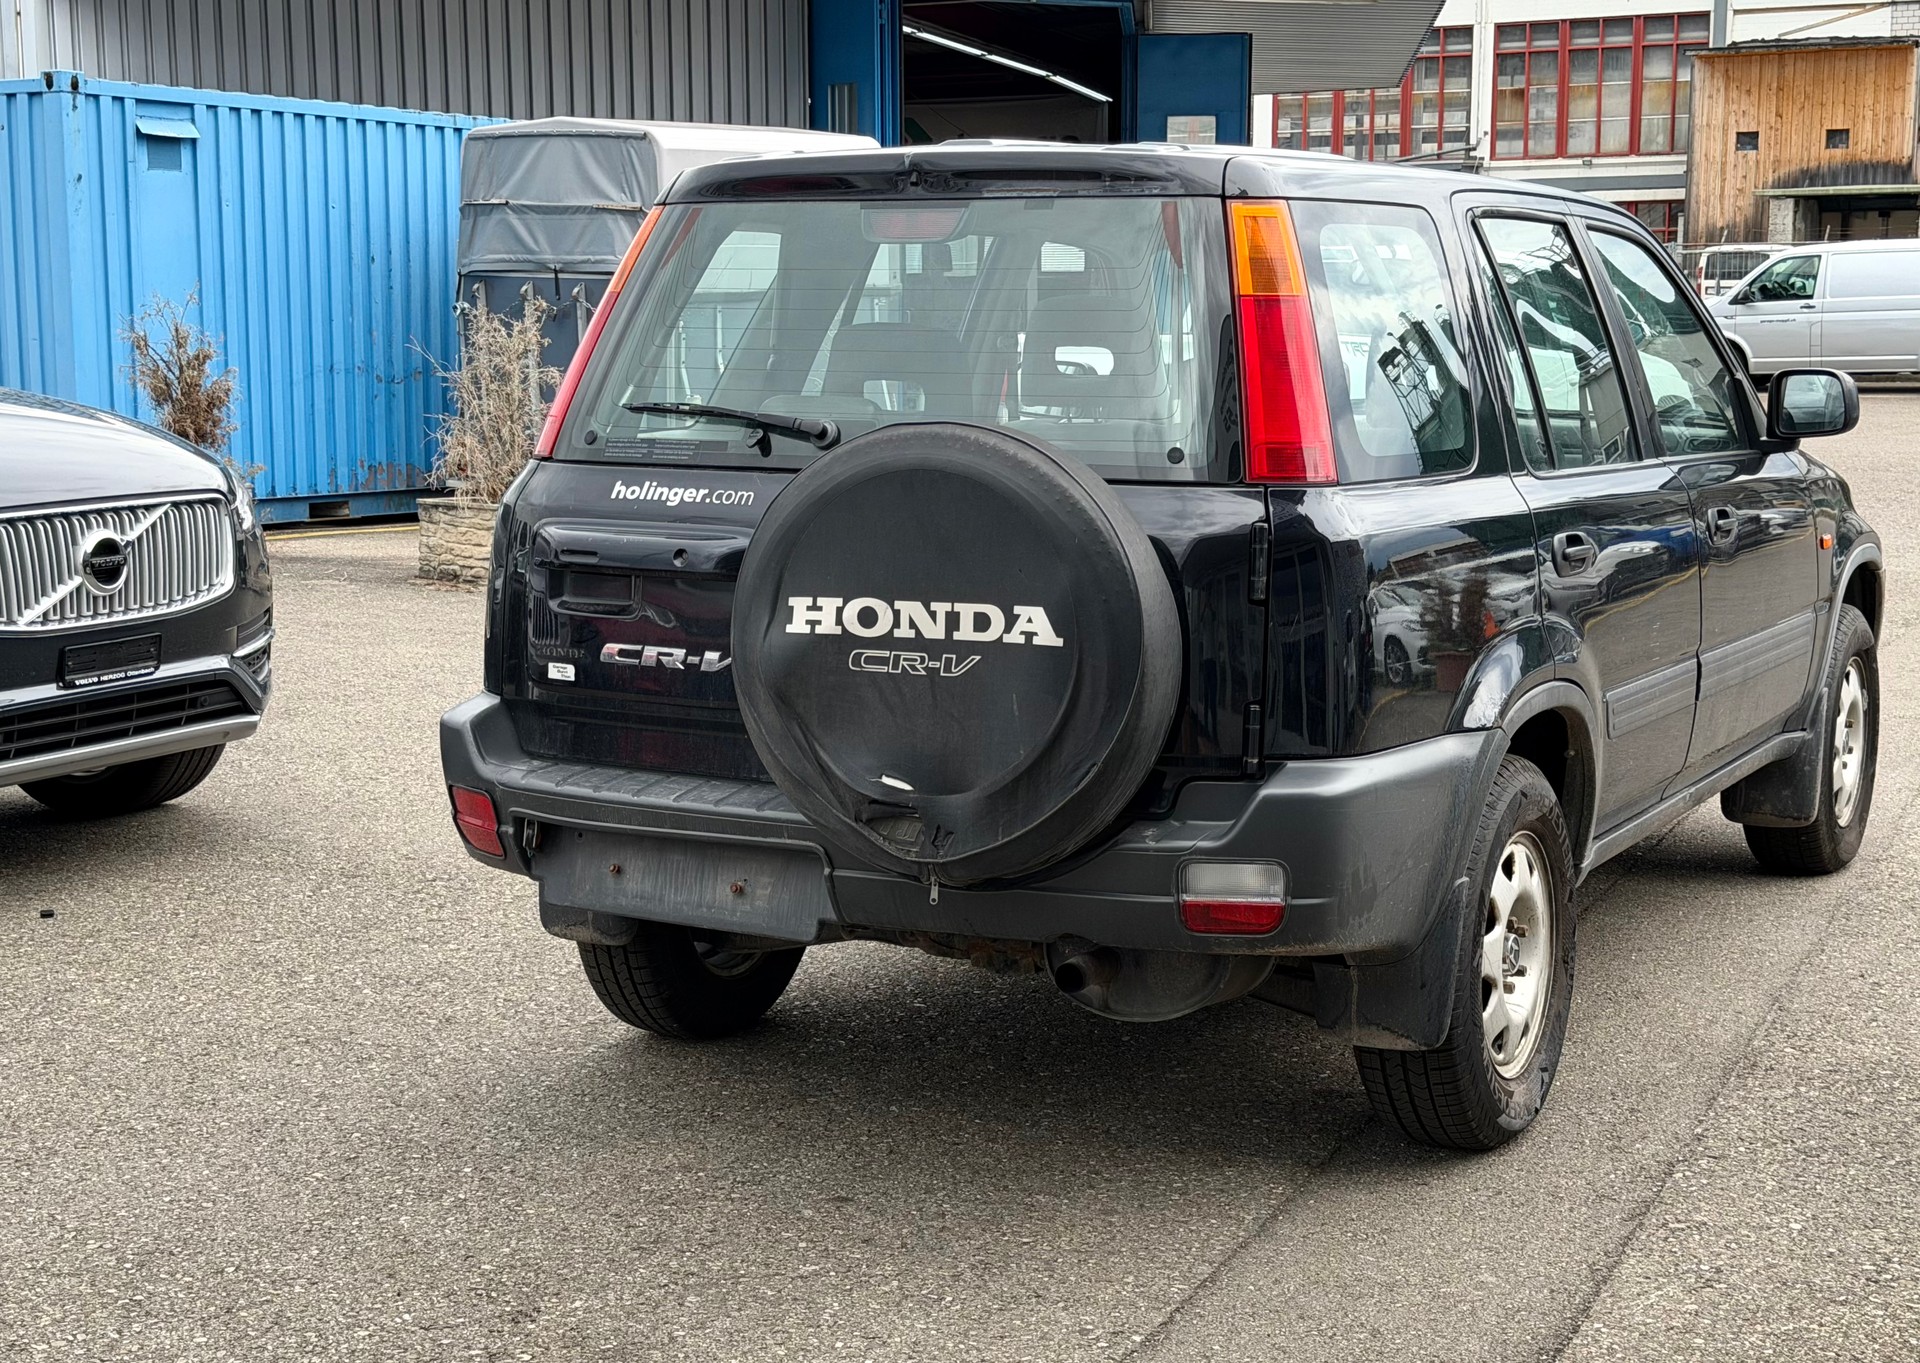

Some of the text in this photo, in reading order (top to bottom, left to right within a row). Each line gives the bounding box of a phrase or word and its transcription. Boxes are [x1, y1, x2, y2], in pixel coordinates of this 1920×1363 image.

[610, 480, 755, 506] holinger.com
[91, 556, 125, 568] VOLVO
[785, 596, 1064, 647] HONDA
[599, 643, 732, 672] CR-V
[849, 649, 982, 676] CR-V
[75, 676, 99, 686] VOLVO
[100, 672, 126, 682] HERZOG
